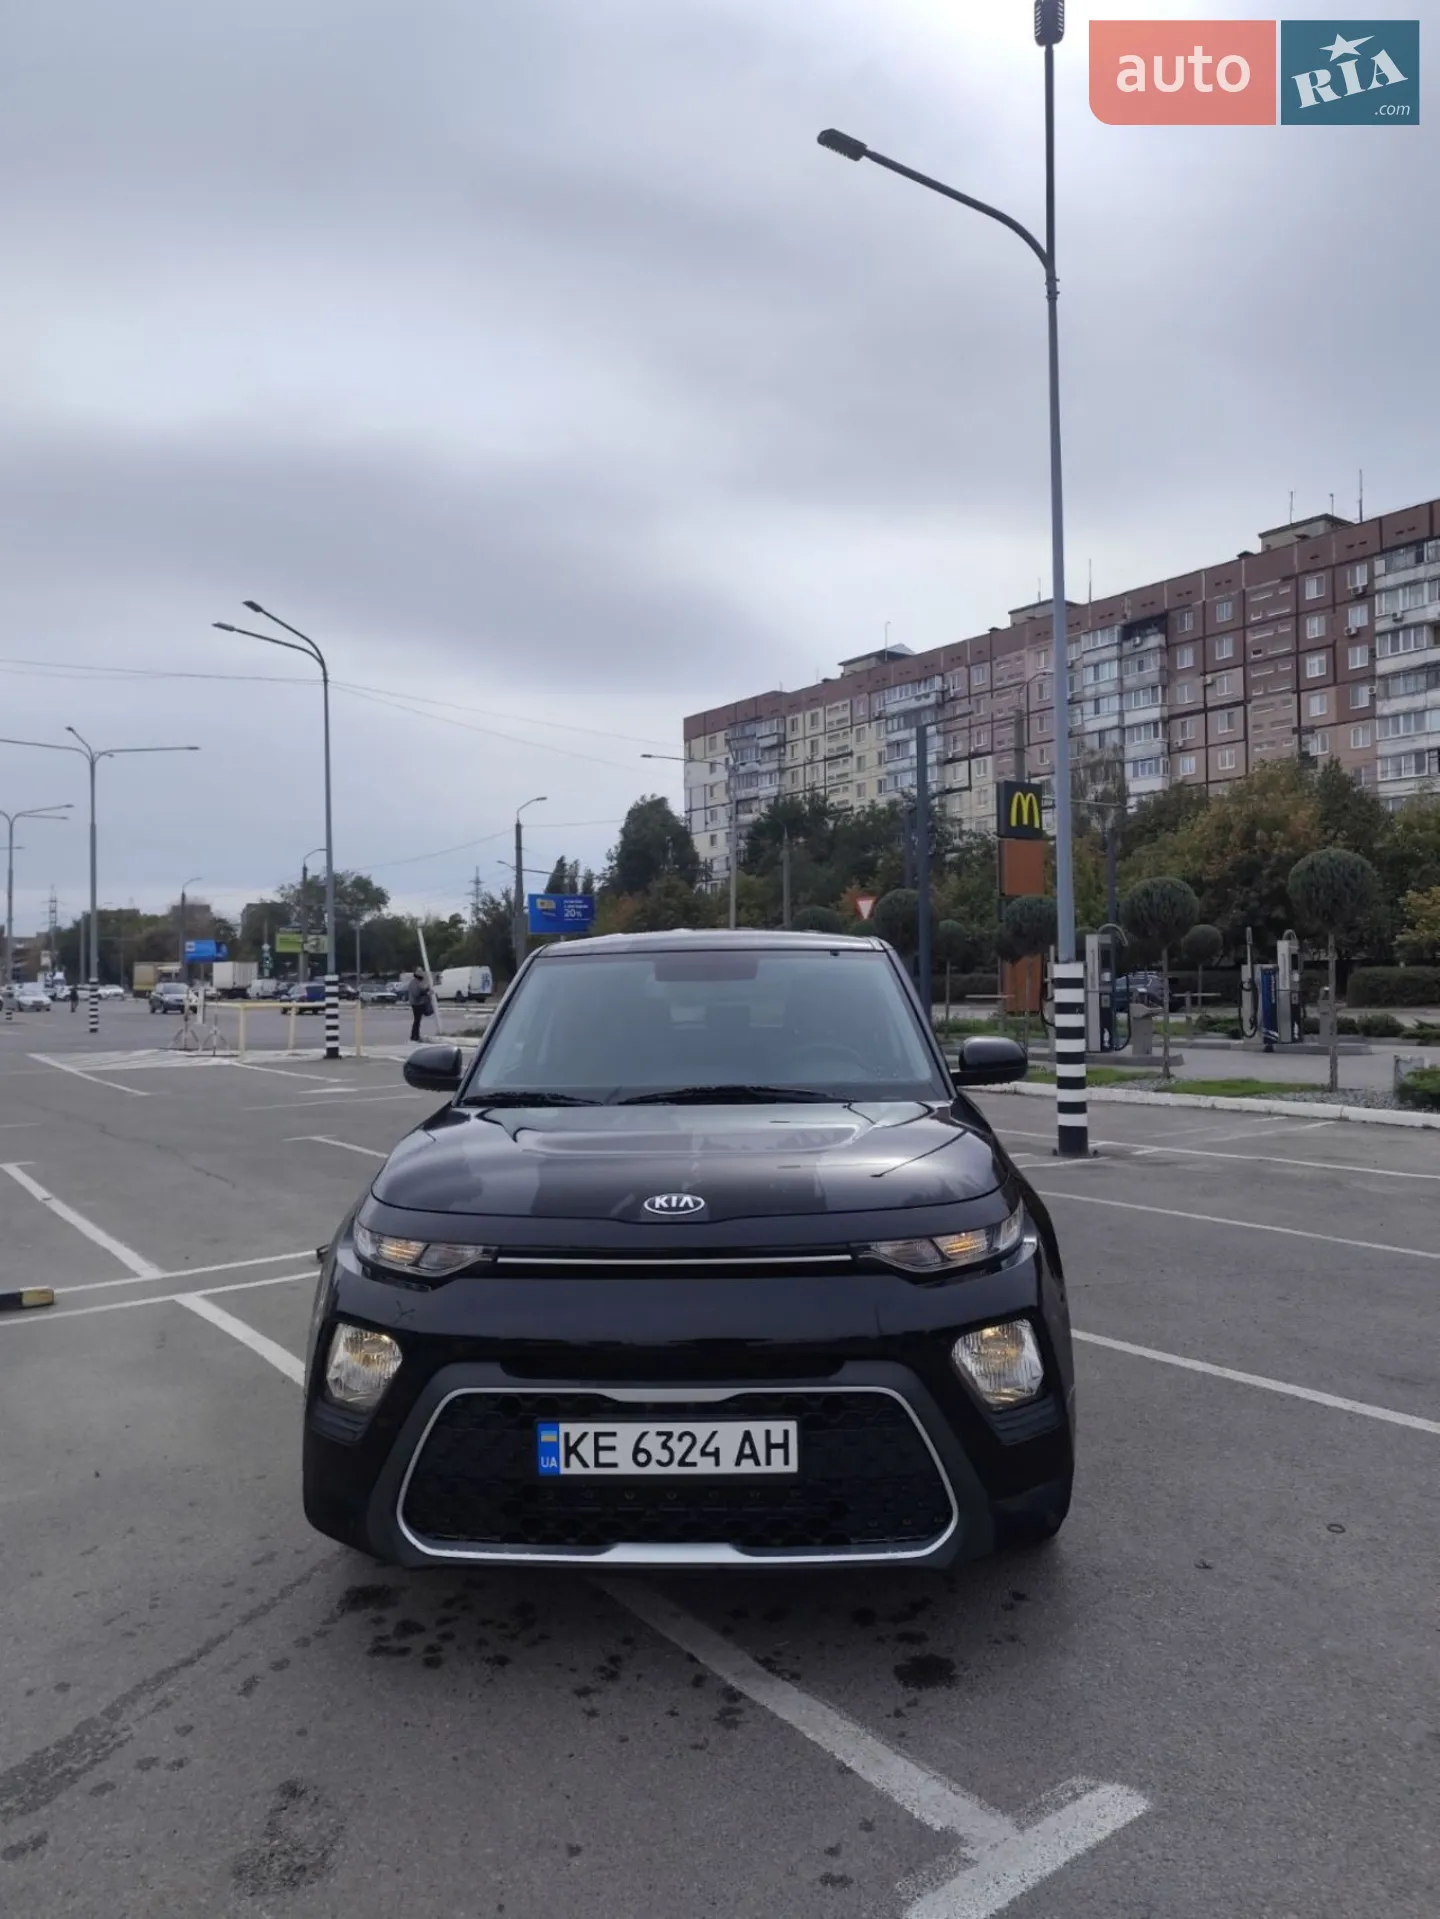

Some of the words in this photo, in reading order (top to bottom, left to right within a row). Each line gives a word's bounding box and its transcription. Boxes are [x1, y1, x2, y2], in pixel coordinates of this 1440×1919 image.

[654, 1195, 695, 1209] KIA
[563, 1431, 619, 1469] KE
[631, 1430, 721, 1468] 6324
[734, 1429, 790, 1467] AH
[540, 1457, 558, 1468] UA
